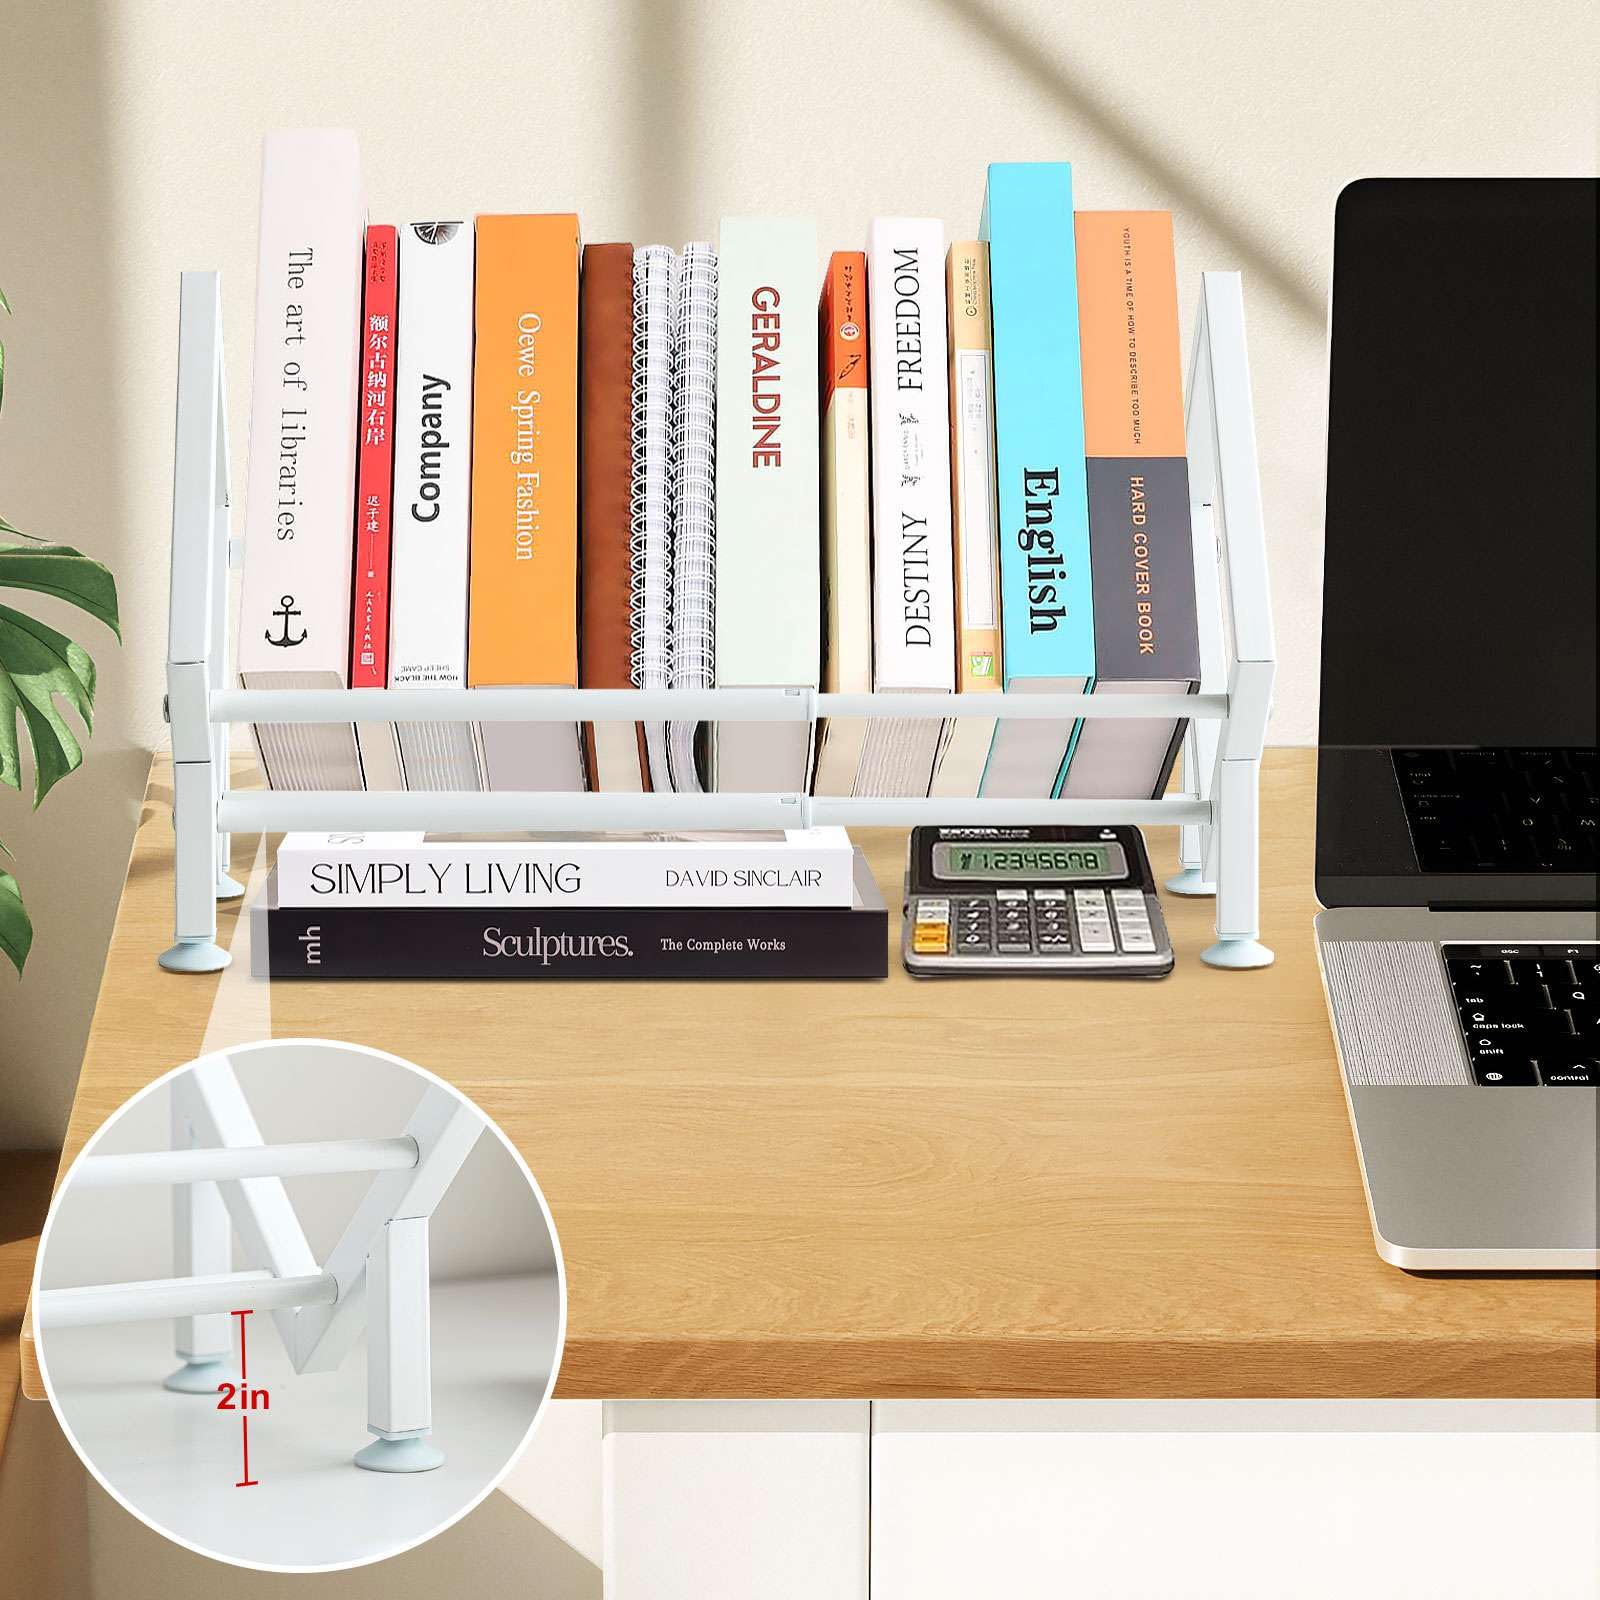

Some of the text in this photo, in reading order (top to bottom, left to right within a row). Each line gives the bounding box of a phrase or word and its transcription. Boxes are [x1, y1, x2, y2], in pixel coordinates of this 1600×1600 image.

[1123, 226, 1131, 255] YOUTH
[1124, 258, 1132, 267] IS
[1126, 278, 1134, 298] TIME
[893, 248, 923, 392] FREEDOM
[1127, 301, 1134, 312] OF
[1128, 315, 1136, 334] HOW
[1129, 337, 1136, 348] TO
[365, 314, 389, 446] 额尔古纳河右岸
[751, 286, 782, 469] GERALDINE
[1129, 352, 1139, 395] DESCRIBE
[276, 247, 314, 541] The art of libraries
[1132, 399, 1140, 416] TOO
[411, 373, 452, 523] Company
[511, 313, 543, 561] Oewe Spring Fashion
[1133, 419, 1141, 445] MUCH
[1017, 466, 1067, 635] English
[1129, 475, 1154, 655] HARD COVER BOOK
[901, 511, 932, 648] DESTINY
[394, 674, 421, 683] BLACK
[422, 673, 437, 682] THE
[310, 862, 823, 895] SIMPLY LIVING DAVID SINCLAIR
[482, 926, 634, 966] Sculptures.
[660, 938, 683, 951] The
[686, 938, 743, 955] Complete
[746, 938, 786, 951] Works
